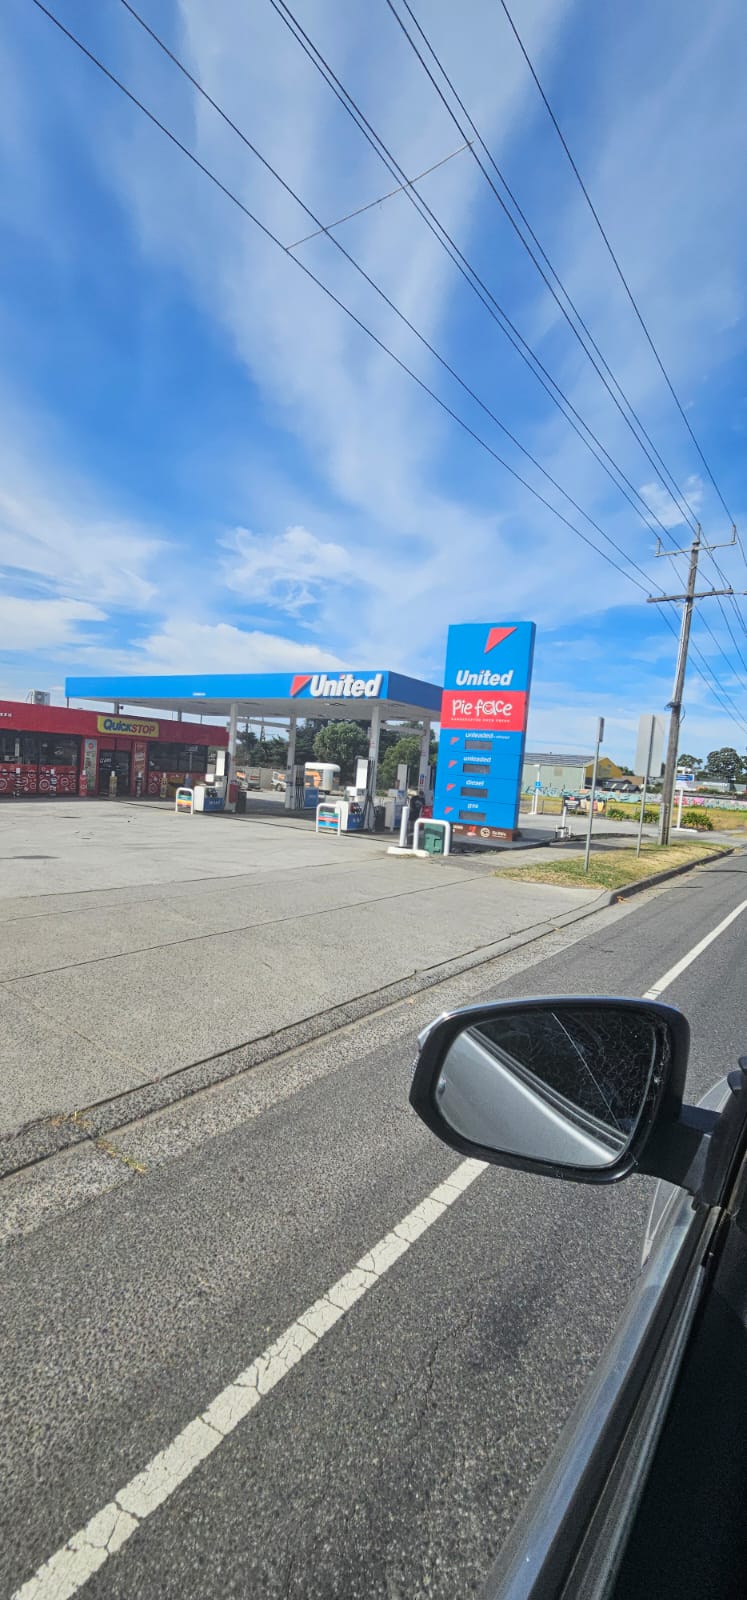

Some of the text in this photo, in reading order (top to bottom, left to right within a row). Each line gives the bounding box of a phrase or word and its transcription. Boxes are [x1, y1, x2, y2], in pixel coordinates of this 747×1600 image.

[310, 673, 383, 697] United
[455, 669, 514, 686] United
[451, 699, 513, 717] Pie face
